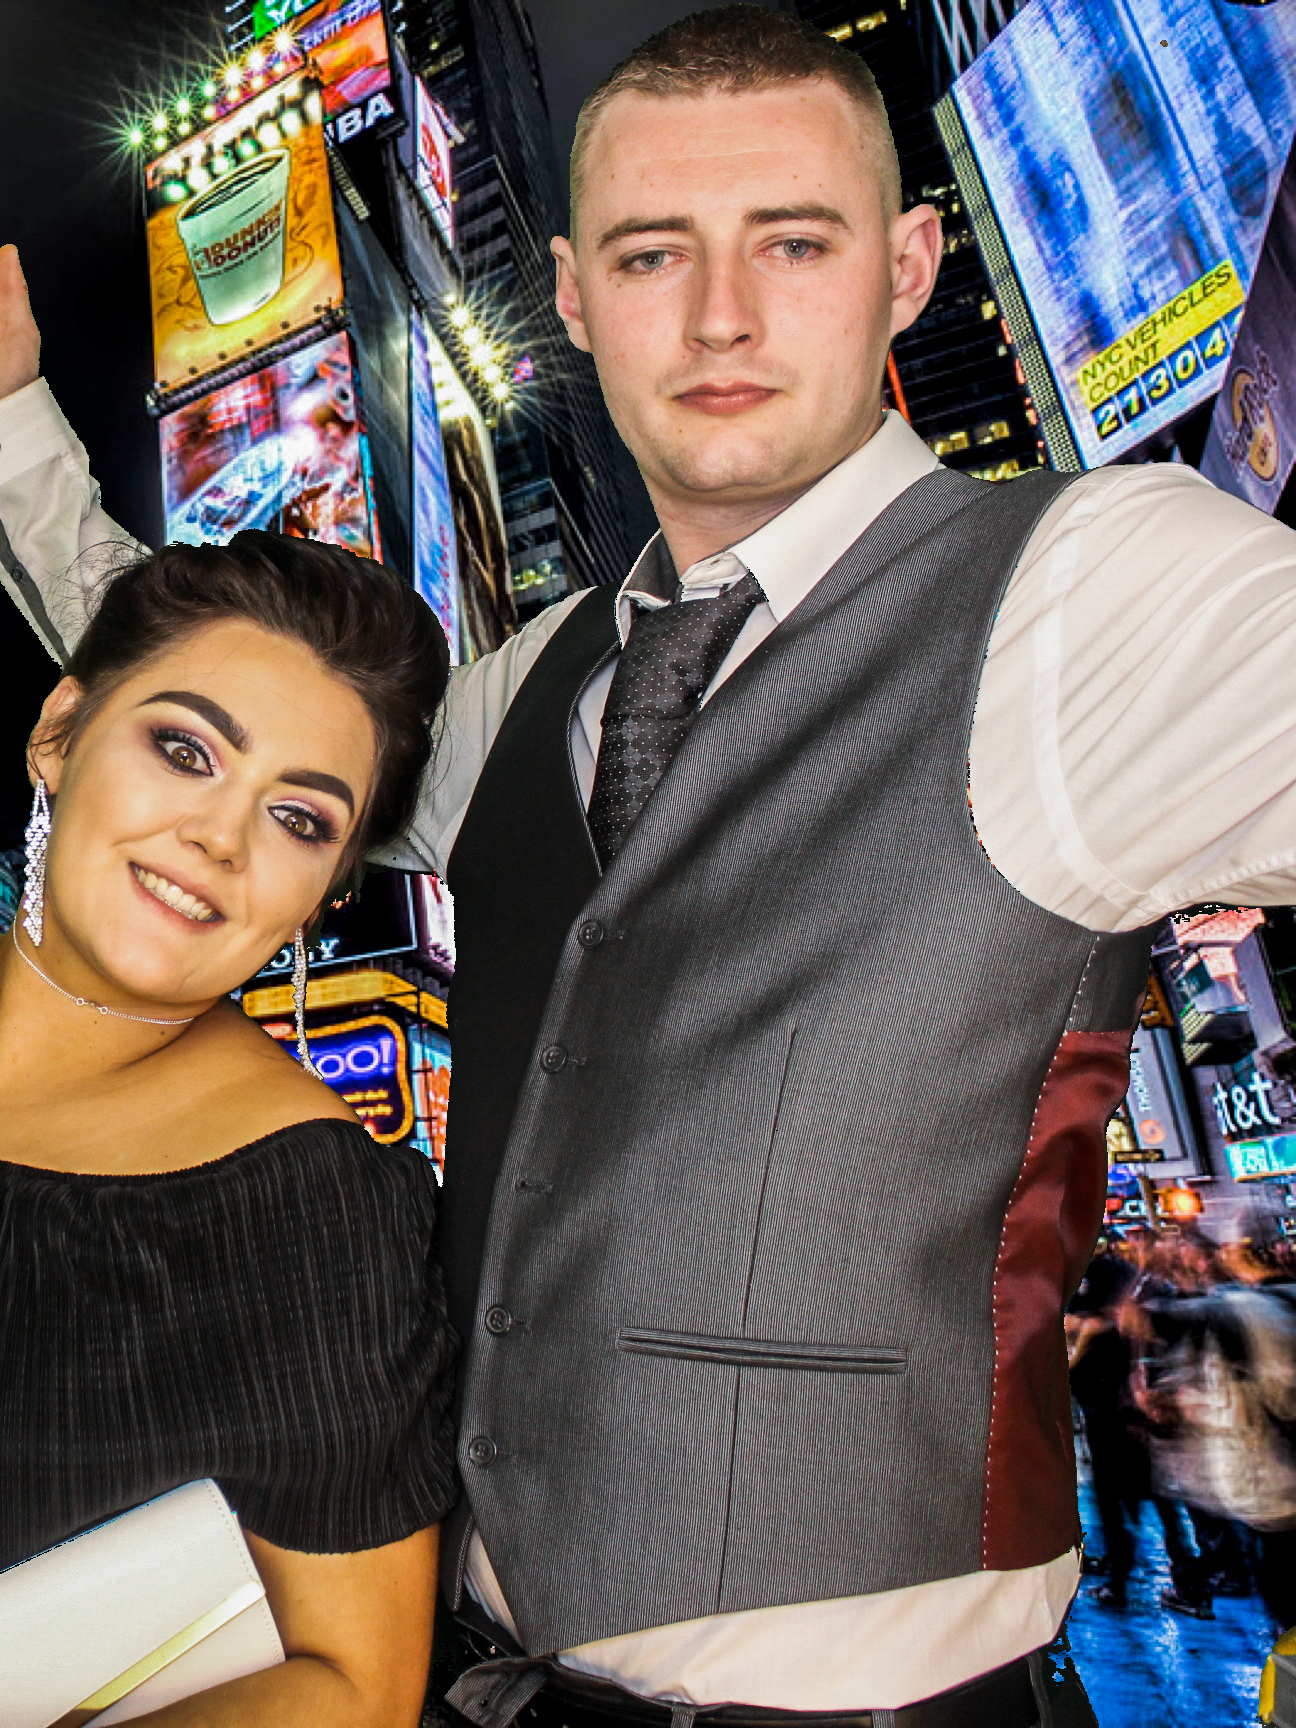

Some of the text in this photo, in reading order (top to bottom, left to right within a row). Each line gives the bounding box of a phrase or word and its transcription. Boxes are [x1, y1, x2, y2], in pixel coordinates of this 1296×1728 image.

[1083, 263, 1232, 386] NYC VEHICLES
[1089, 339, 1160, 402] COUNT
[312, 1036, 394, 1080] OO!
